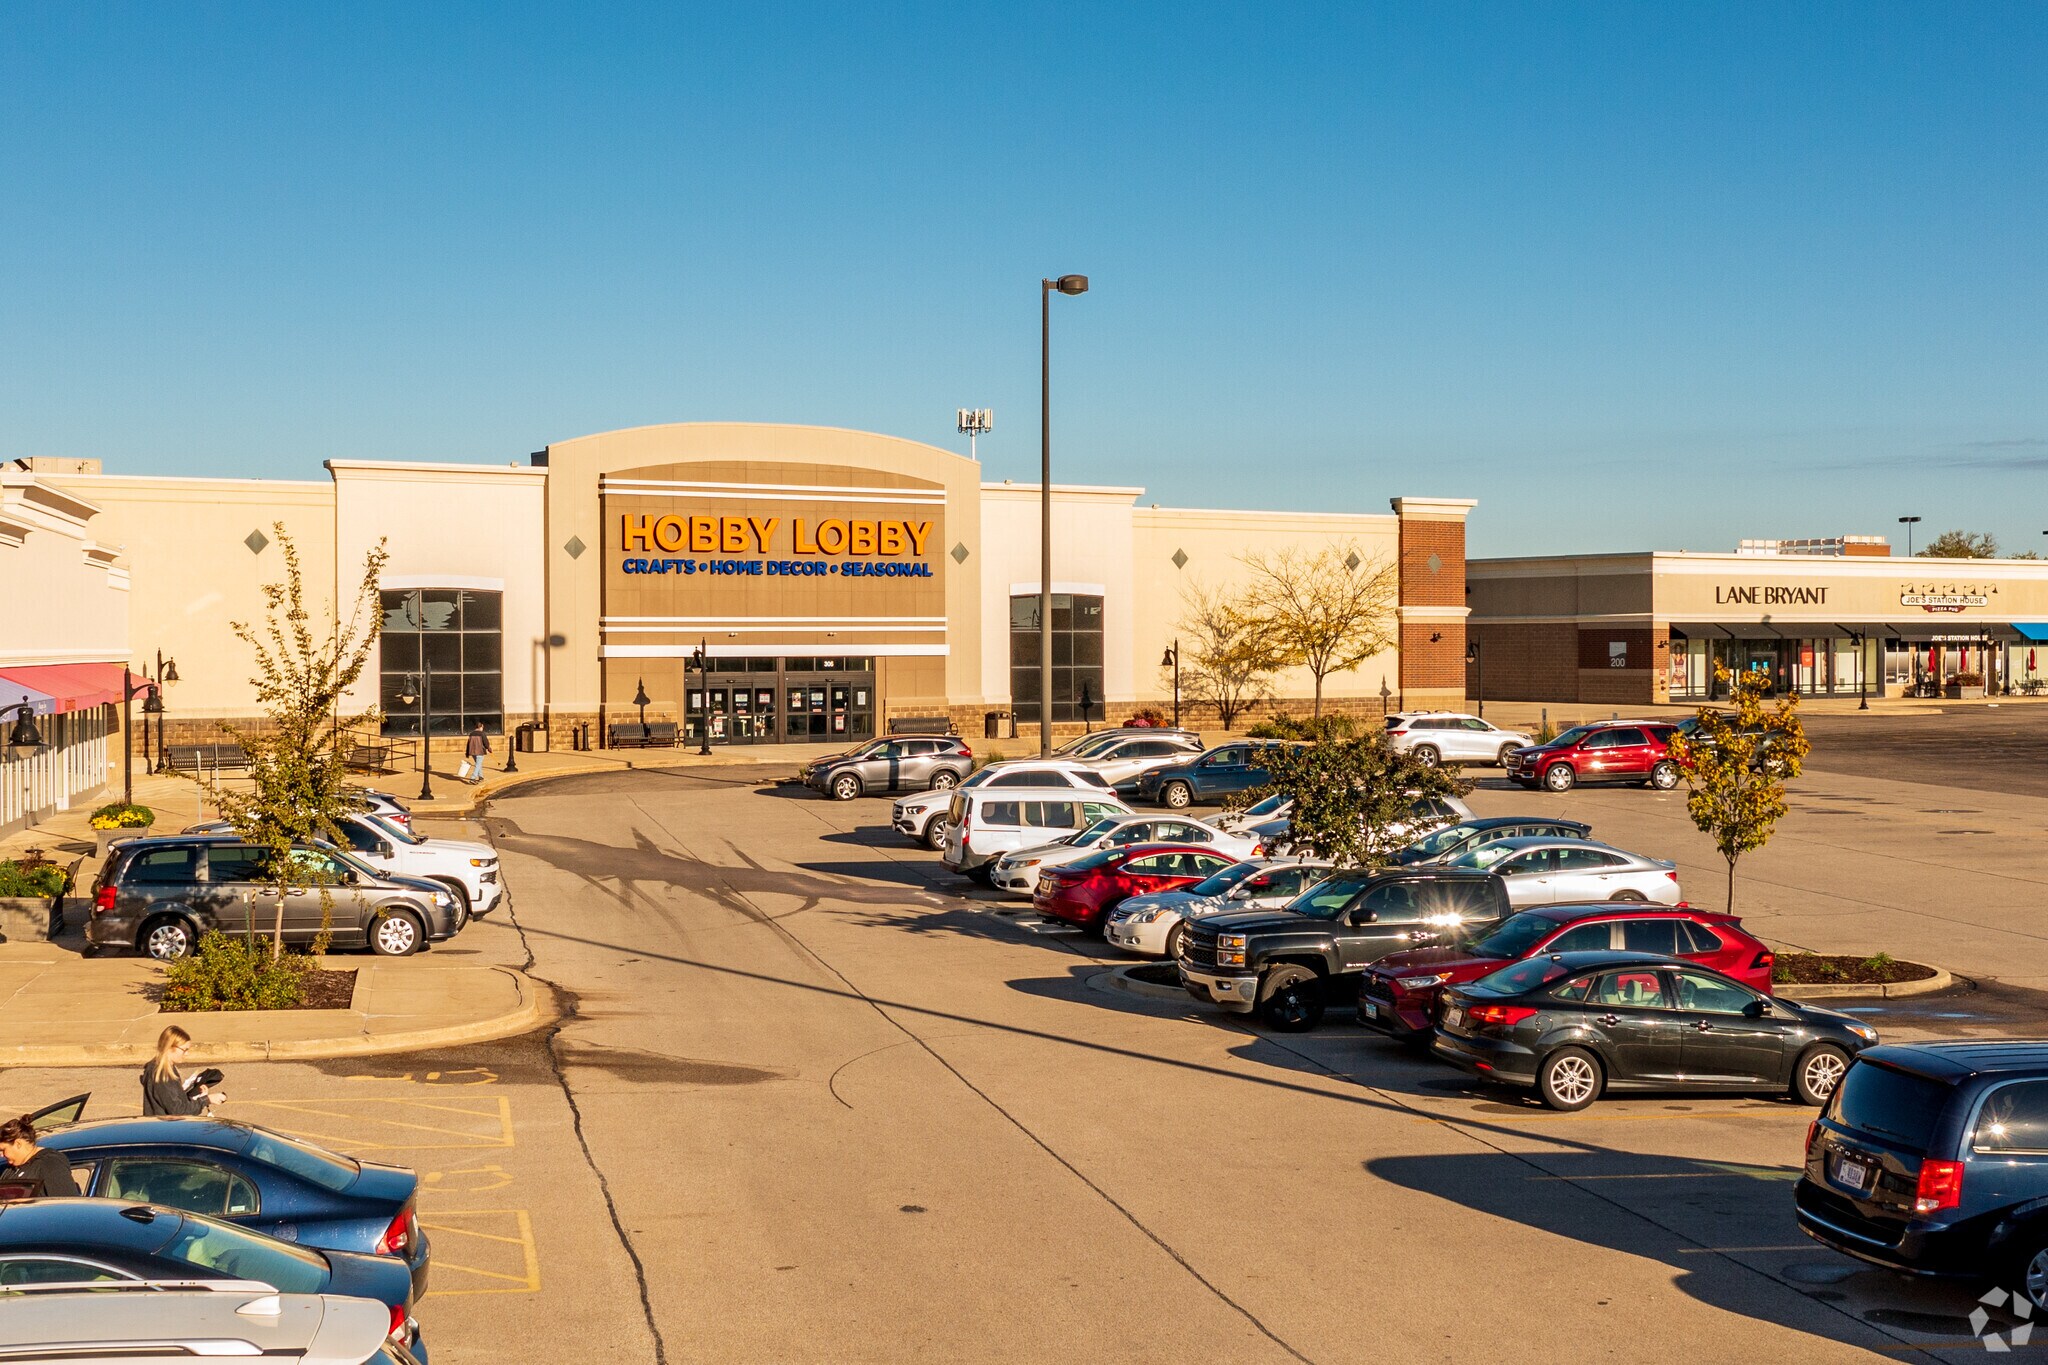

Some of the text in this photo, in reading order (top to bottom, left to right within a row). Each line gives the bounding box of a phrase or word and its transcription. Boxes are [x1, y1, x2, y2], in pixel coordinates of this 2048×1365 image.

[622, 514, 934, 557] HOBBY LOBBY
[622, 558, 933, 577] CRAFTS HOME DECOR SEASONAL
[1715, 586, 1830, 605] LANE BRYANT
[1906, 596, 1984, 605] JOE'S STATION HOUSE
[1610, 657, 1626, 667] 200
